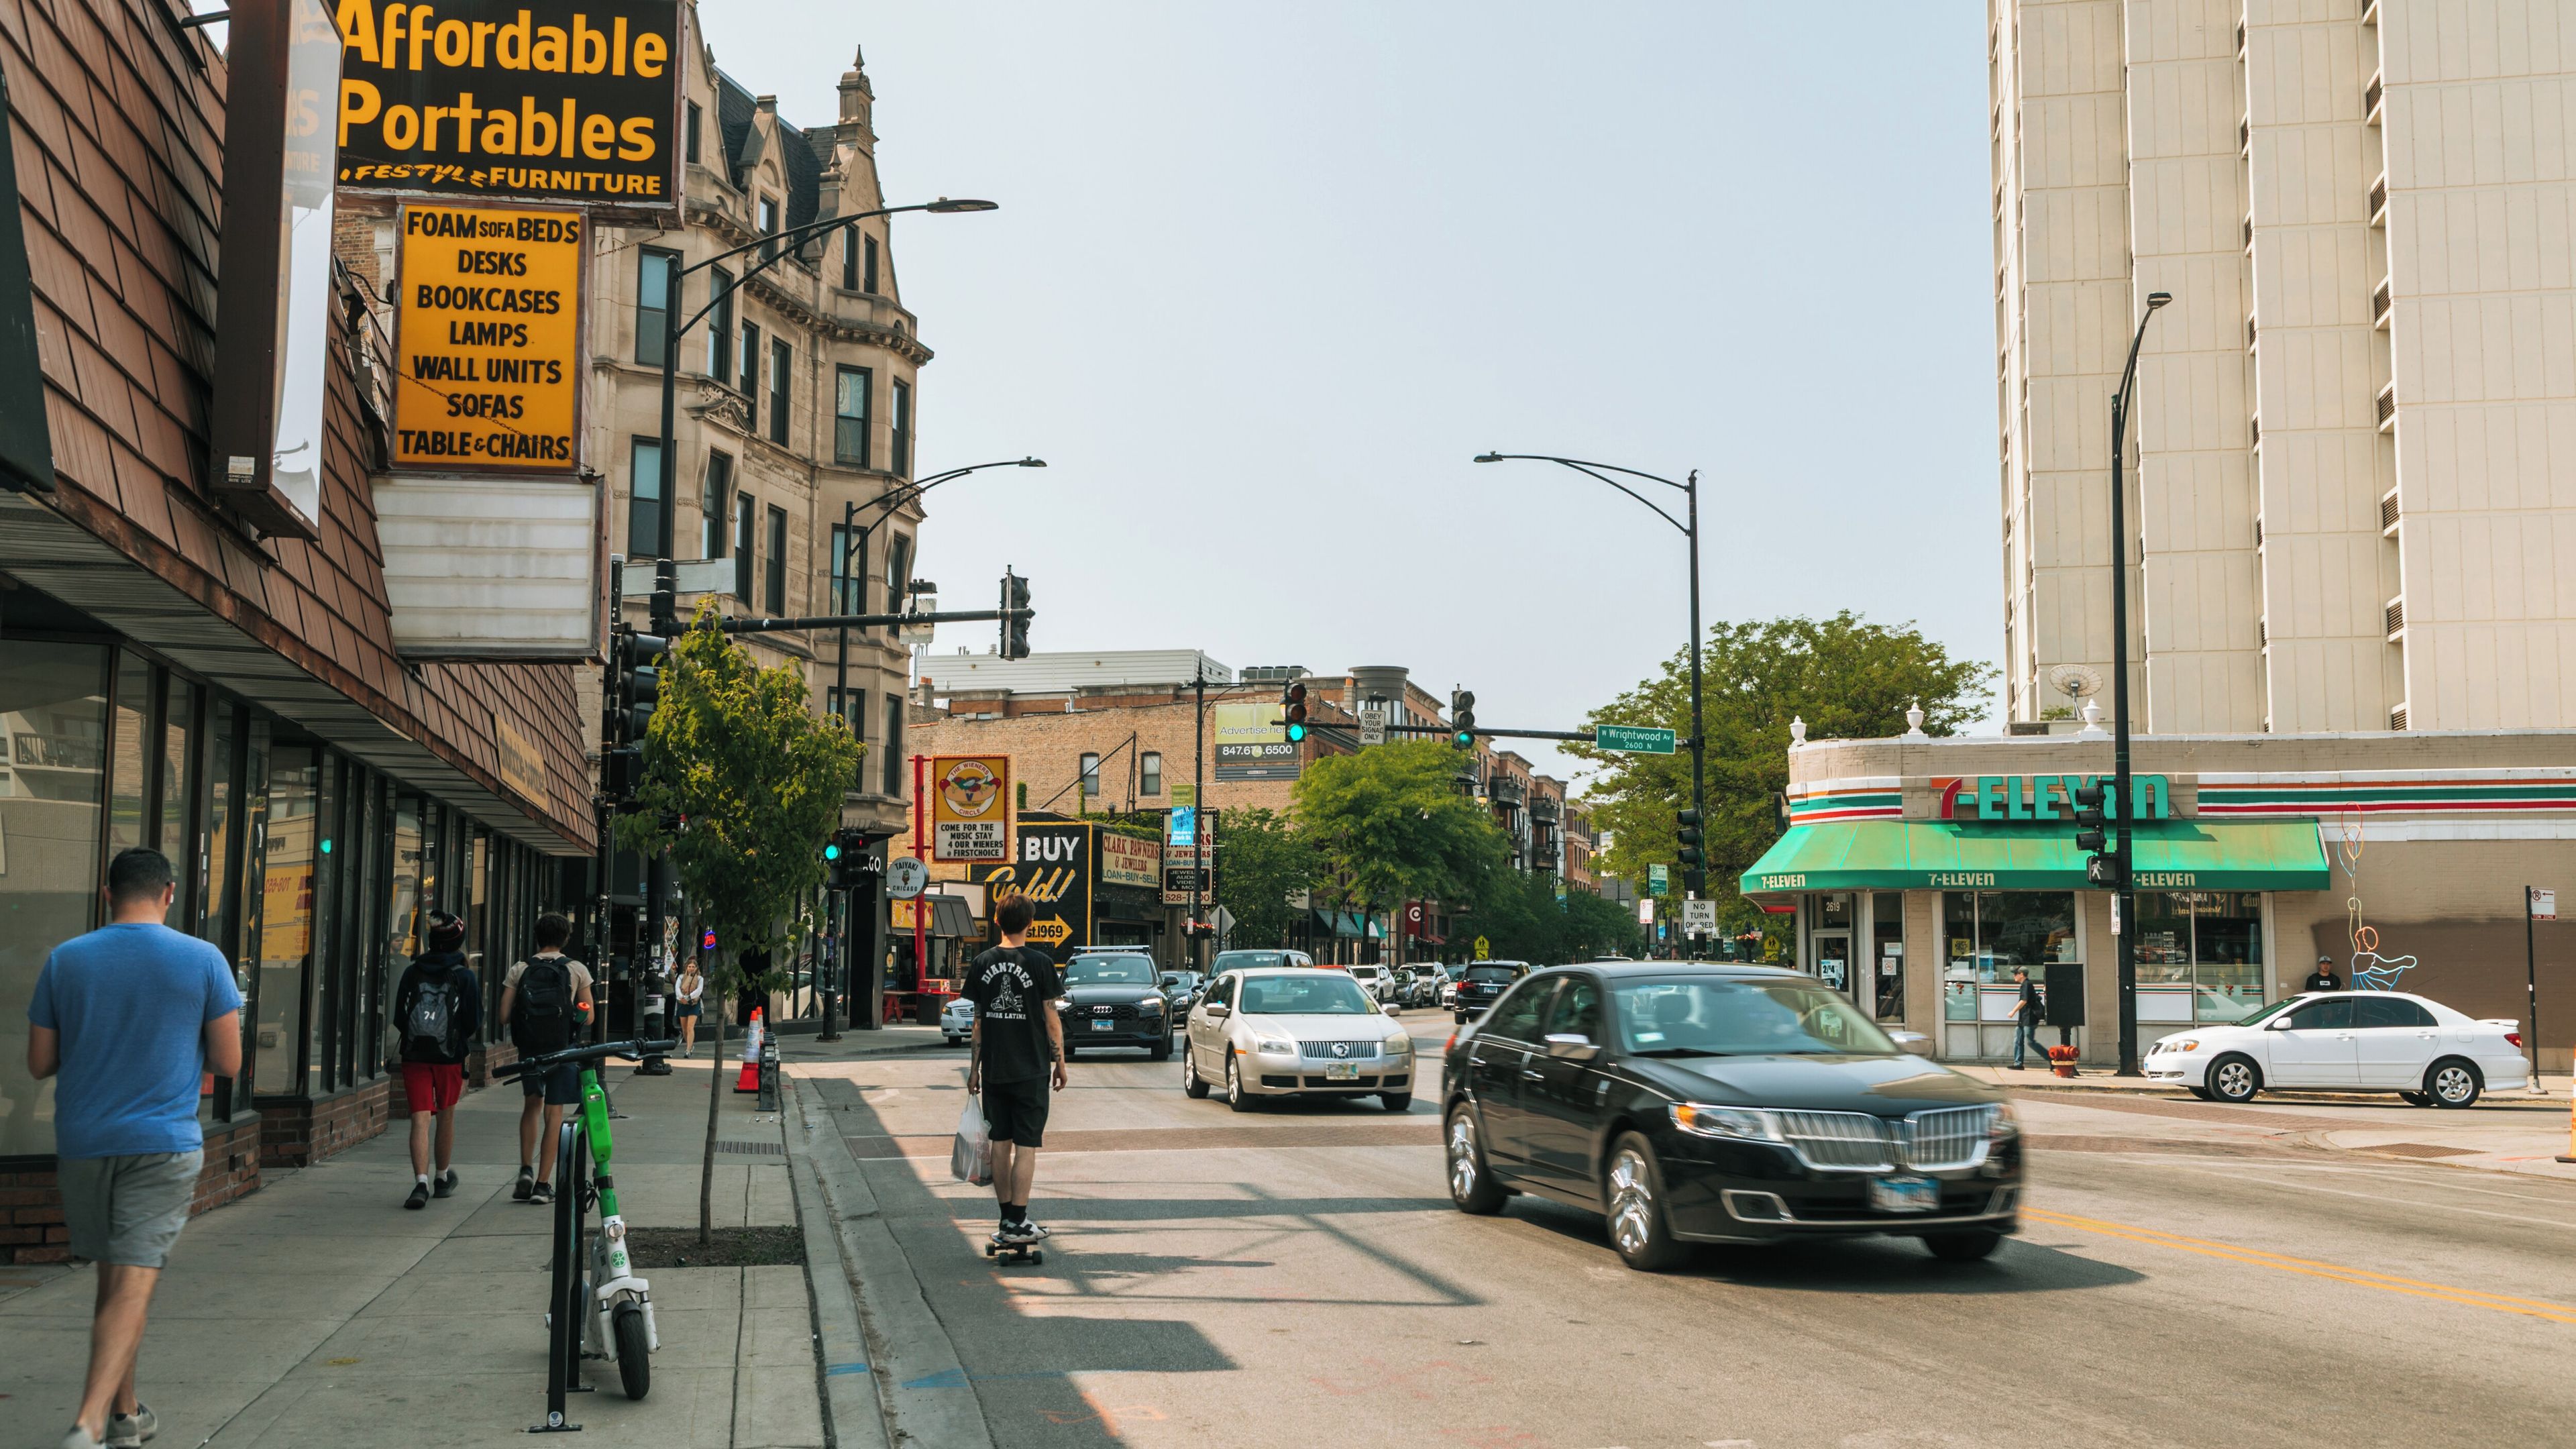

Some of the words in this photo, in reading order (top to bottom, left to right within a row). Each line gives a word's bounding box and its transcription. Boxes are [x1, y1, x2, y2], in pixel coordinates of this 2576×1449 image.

[336, 0, 667, 78] Affordable
[339, 78, 656, 162] Portables
[490, 166, 661, 195] FURNITURE
[407, 211, 477, 238] FOAM
[479, 221, 515, 239] SOFA
[517, 217, 579, 244] BEDS
[458, 249, 527, 276] DESKS
[417, 284, 560, 315] BOOKCASES
[449, 321, 528, 347] LAMPS
[413, 355, 480, 382] WALL
[486, 358, 562, 384] UNITS
[447, 392, 524, 419] SOFAS
[398, 429, 472, 456] TABLE
[474, 437, 486, 452] &
[486, 433, 570, 460] CHAIRS
[1220, 726, 1267, 735] Advertise
[1269, 725, 1285, 734] her
[1609, 729, 1660, 741] Wrightwood
[1222, 745, 1293, 755] 847.674.6500
[1625, 741, 1643, 749] 2600
[950, 767, 961, 777] THE
[963, 762, 988, 775] WIENERS
[950, 832, 972, 840] MUSIC
[980, 823, 994, 831] THE
[953, 849, 1000, 857] FIRSTCHOICE
[1025, 837, 1080, 861] BUY
[1104, 835, 1127, 855] CLARK
[1130, 839, 1159, 860] PAWNERS
[894, 861, 918, 871] TAIYAKI
[1102, 869, 1159, 884] LOAN-BUY-SELL
[1121, 857, 1147, 872] JEWELERS
[1826, 902, 1840, 912] 2619
[981, 962, 1033, 989] DIANTRES
